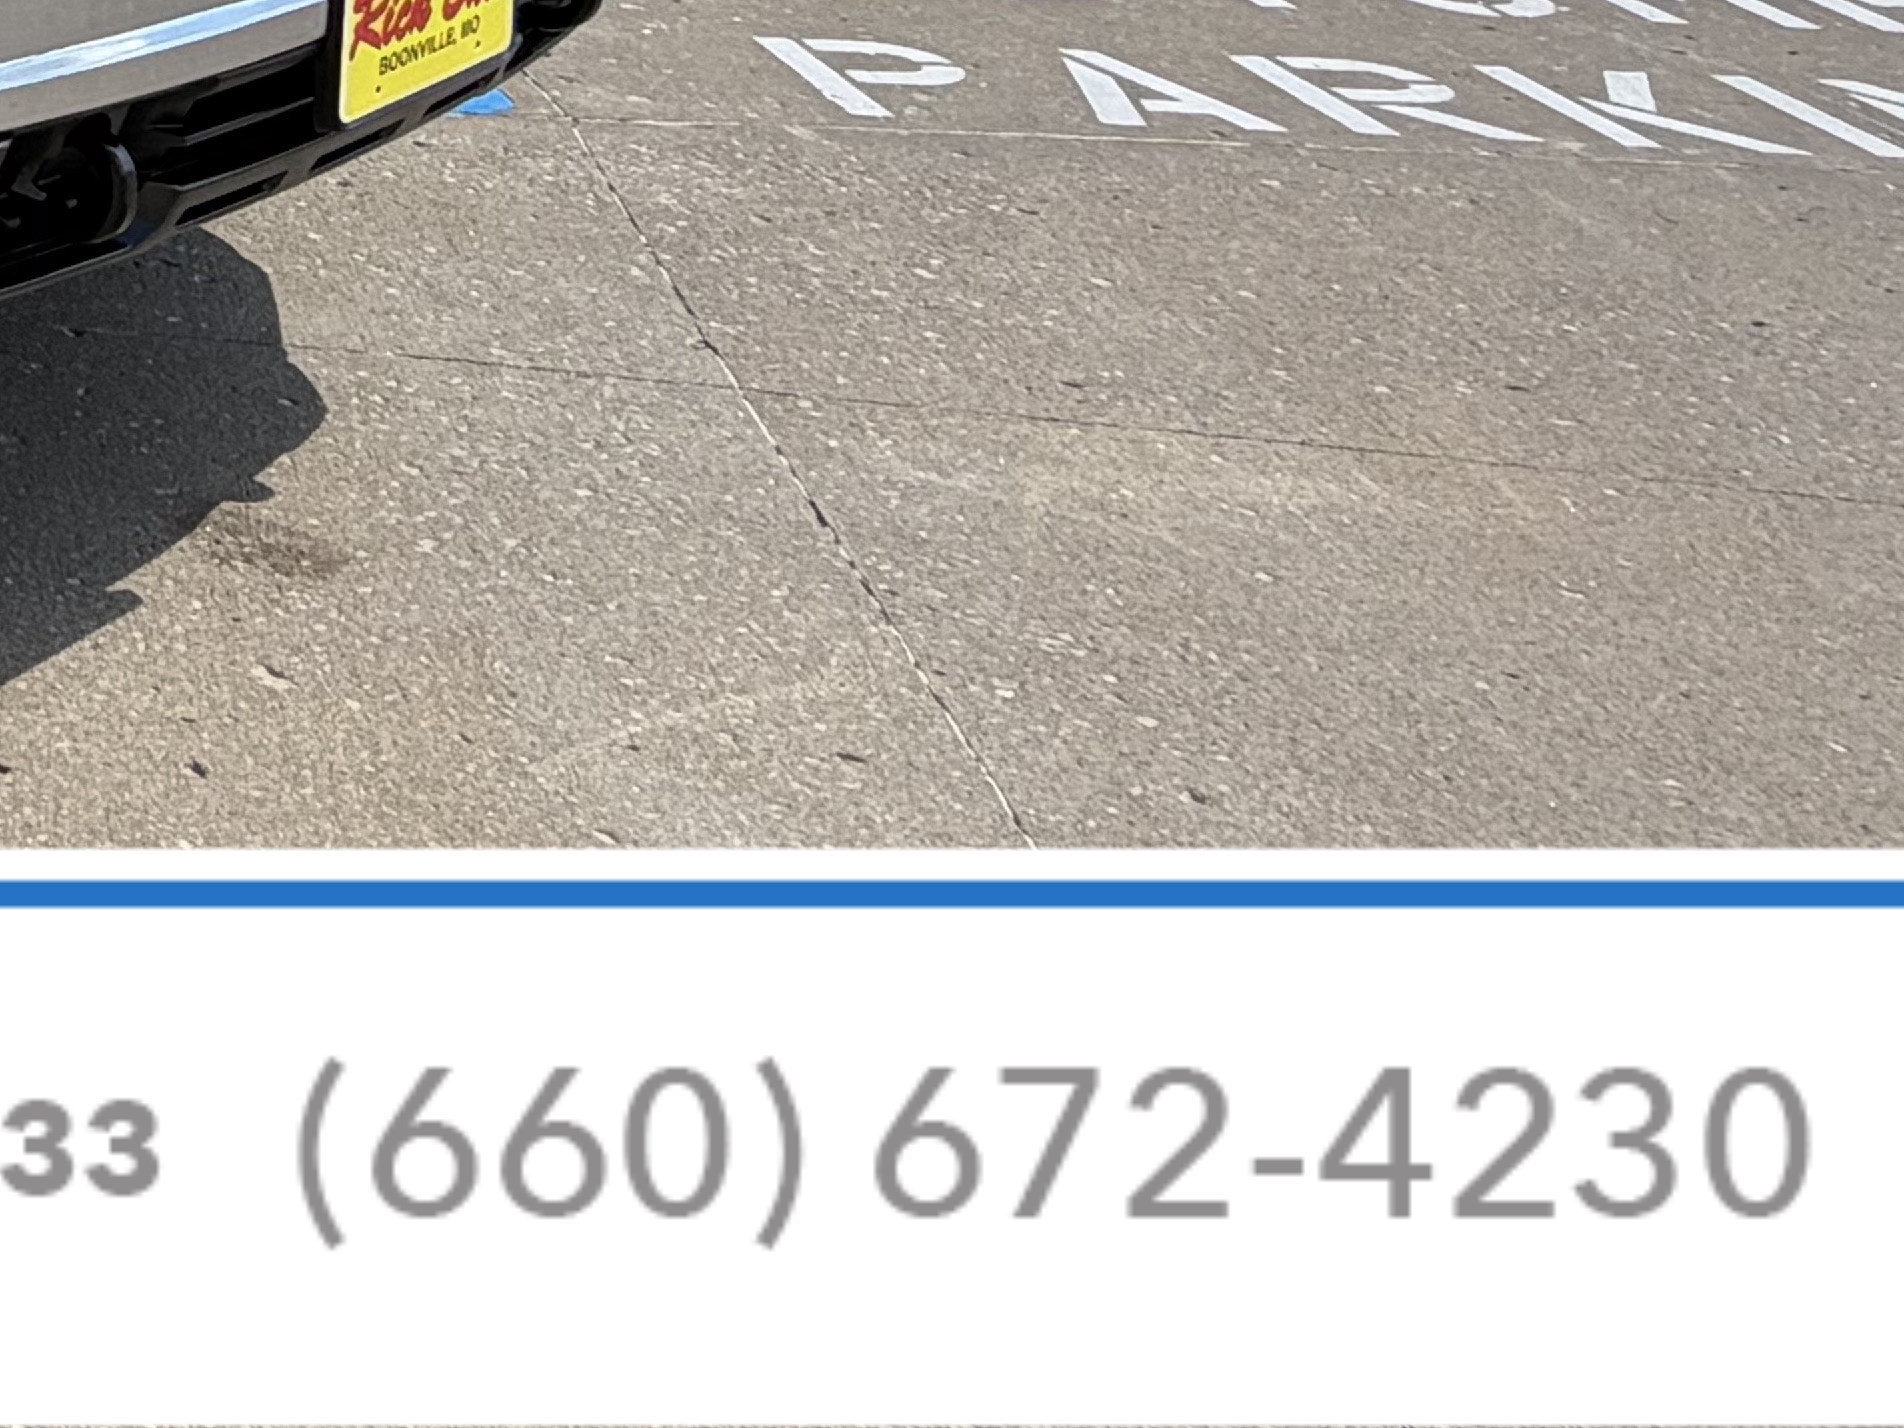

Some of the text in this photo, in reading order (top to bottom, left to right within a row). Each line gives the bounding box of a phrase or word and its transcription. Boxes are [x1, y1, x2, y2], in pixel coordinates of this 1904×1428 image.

[379, 15, 481, 76] BOONVILLE, MO
[753, 36, 1904, 159] PARKI
